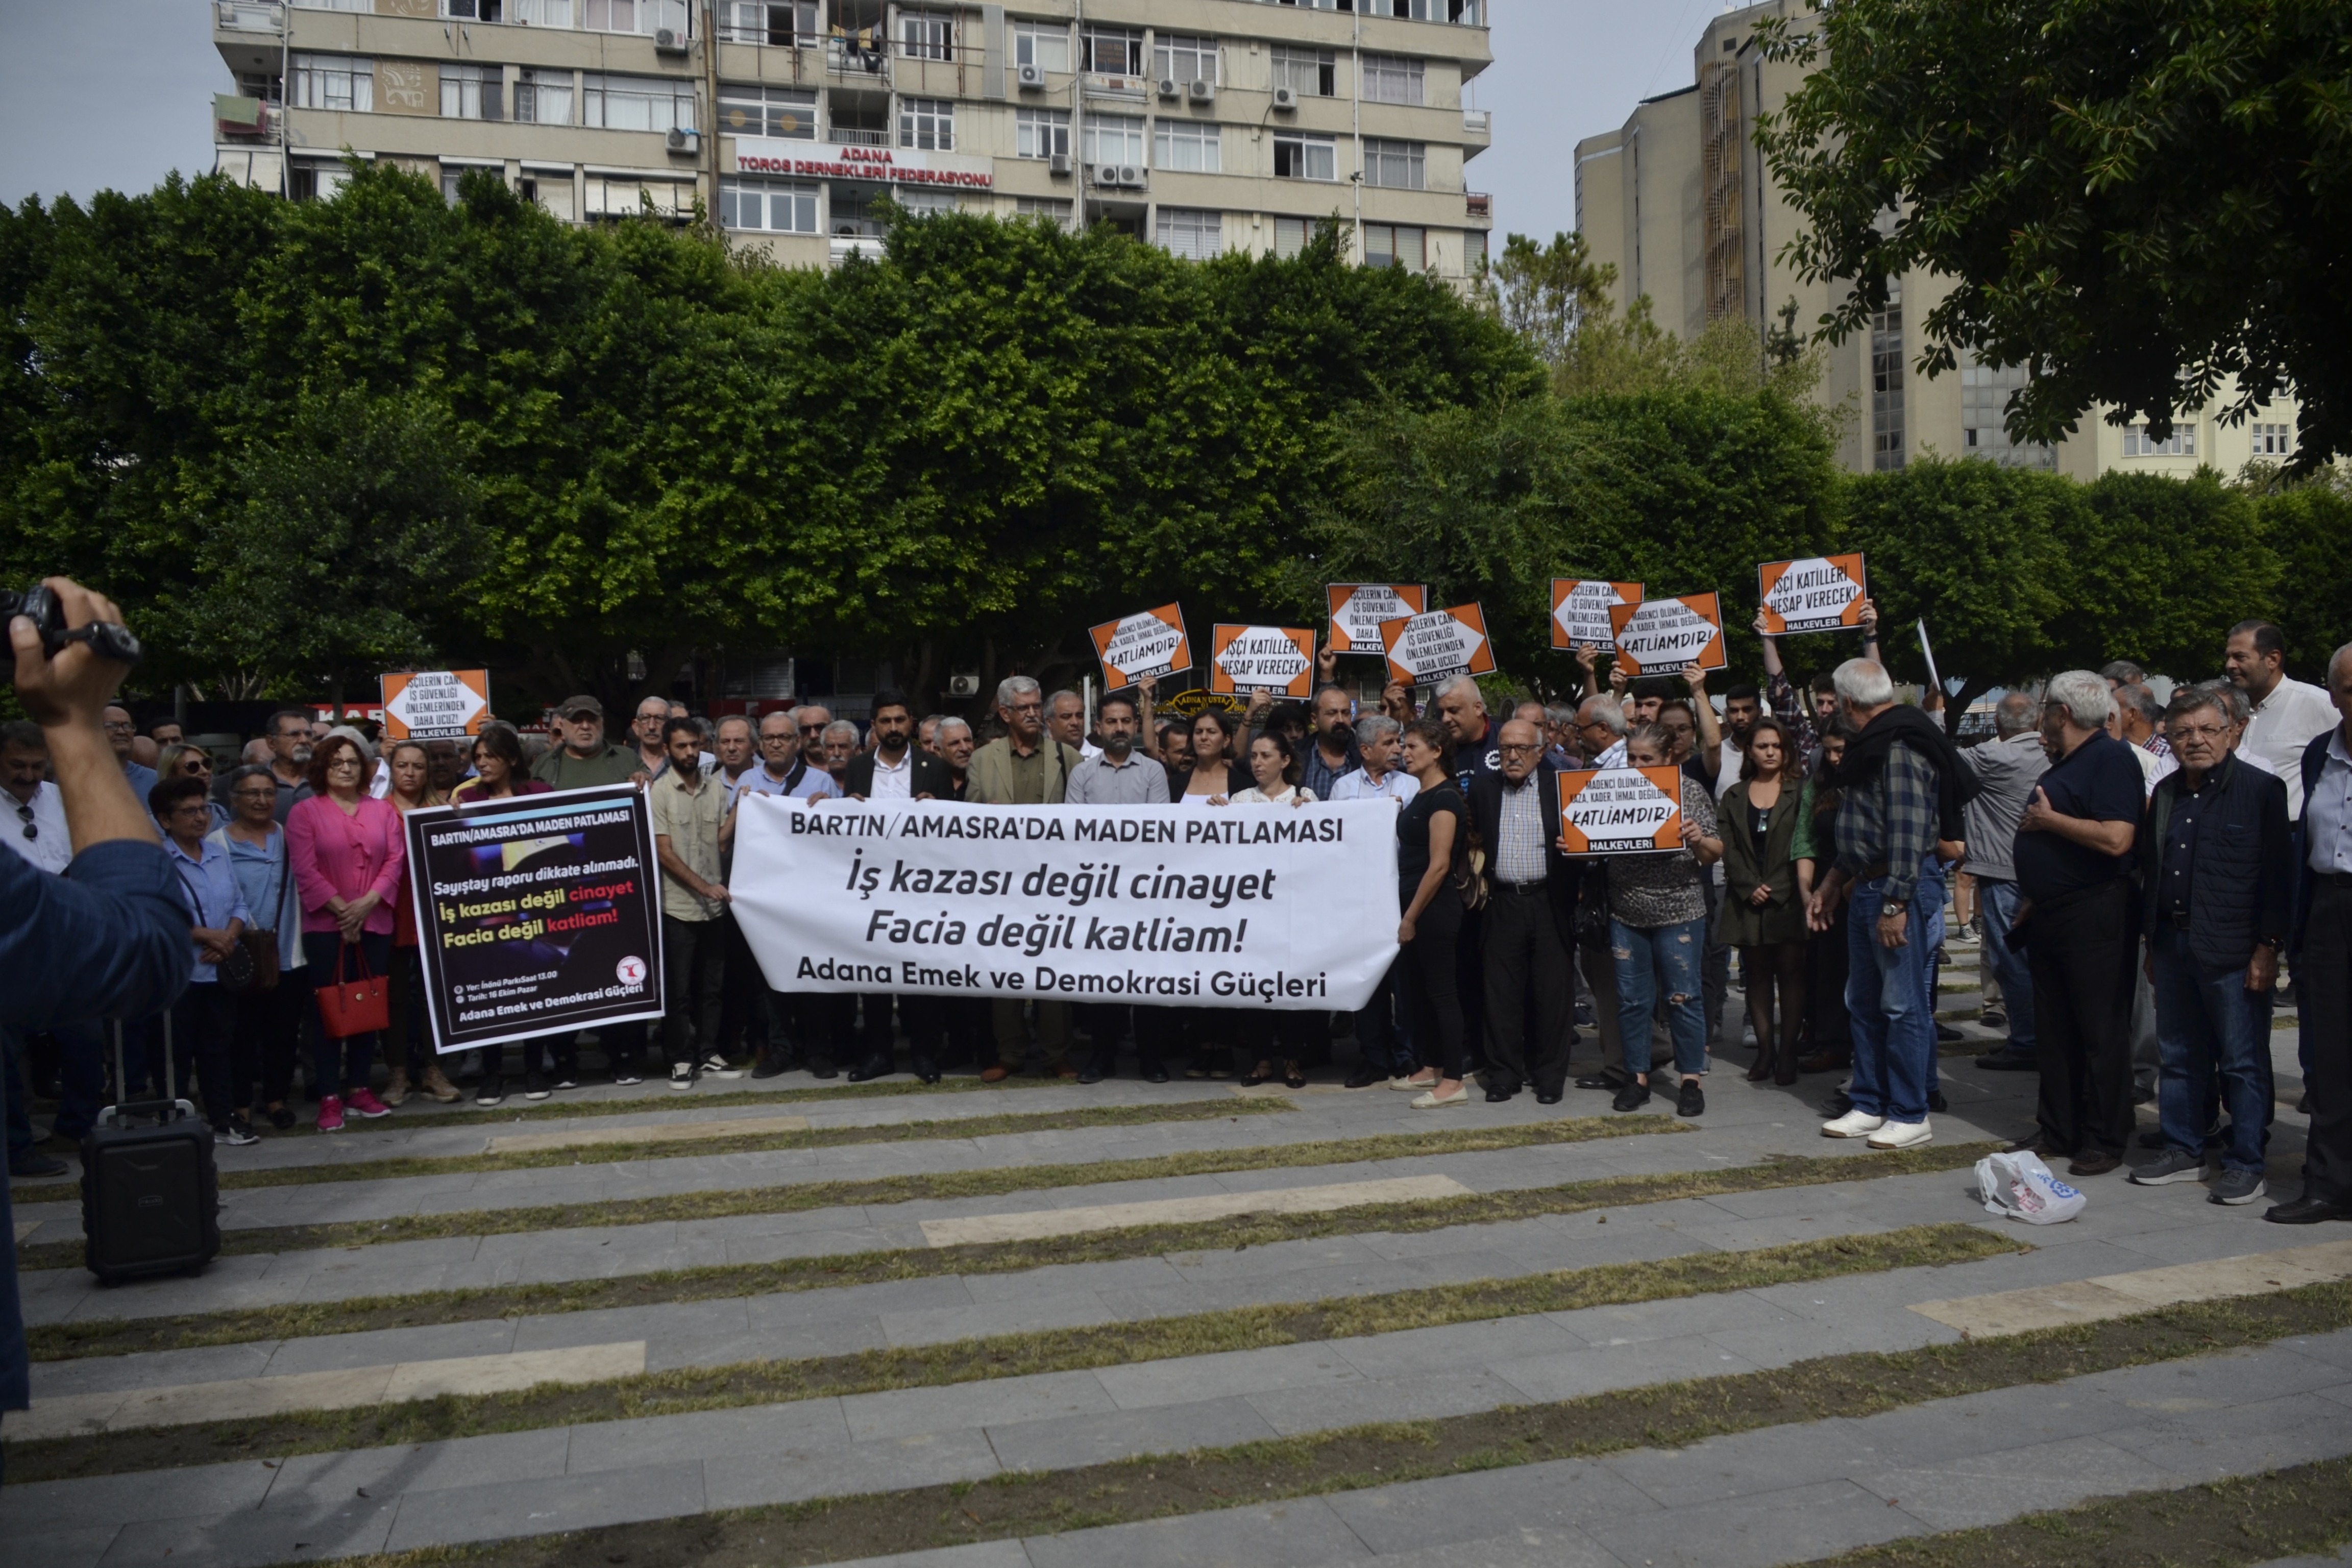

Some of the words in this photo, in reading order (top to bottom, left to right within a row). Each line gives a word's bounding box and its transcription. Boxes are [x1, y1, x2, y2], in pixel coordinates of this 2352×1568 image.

[840, 148, 893, 163] ADANA
[738, 156, 791, 172] TOROS
[795, 161, 887, 179] DERNEKLERİ
[889, 168, 992, 187] FEDERASYONU
[1774, 573, 1793, 596] İŞÇİ
[1797, 563, 1847, 589] KATİLLERİ
[1350, 589, 1381, 600] İŞÇİLERİN
[1384, 590, 1400, 599] CANI
[1571, 584, 1599, 596] İŞÇİLERİN
[1602, 586, 1618, 597] CANI
[1354, 601, 1360, 613] İŞ
[1362, 601, 1396, 612] GÜVENLİĞİ
[1572, 598, 1577, 610] İŞ
[1771, 595, 1801, 615] HESAP
[1806, 585, 1856, 609] VERECEK!
[1403, 617, 1436, 632] İŞÇİLERİN
[1439, 612, 1456, 625] CANI
[1632, 607, 1658, 621] MADENCİ
[1660, 605, 1690, 618] ÖLÜMLERİ
[1136, 616, 1160, 630] ÖLÜMLERİ
[1573, 626, 1587, 636] DAHA
[1590, 627, 1611, 638] UCUZ!
[1659, 620, 1679, 629] İHMAL
[1138, 630, 1153, 641] İHMAL
[1356, 629, 1373, 639] DAHA
[1407, 633, 1415, 646] İŞ
[1417, 625, 1455, 643] GÜVENLİĞİ
[1624, 630, 1712, 653] KATLİAMDIR!
[1111, 636, 1179, 668] KATLİAMDIR!
[1226, 637, 1247, 658] İŞÇİ
[1250, 636, 1300, 655] KATİLLERİ
[1406, 639, 1465, 660] ÖNLEMLERİNDEN
[1221, 659, 1253, 675] HESAP
[1257, 659, 1306, 675] VERECEK!
[1416, 658, 1437, 672] DAHA
[1439, 654, 1461, 667] UCUZ!
[406, 675, 442, 688] İŞÇİLERİN
[444, 675, 461, 685] CANI
[410, 689, 416, 700] İŞ
[420, 688, 457, 699] GÜVENLİĞİ
[406, 701, 465, 714] ÖNLEMLERİNDEN
[414, 716, 434, 726] DAHA
[436, 714, 458, 725] UCUZ!
[1586, 777, 1615, 790] MADENCİ
[1618, 775, 1650, 788] ÖLÜMLERİ
[1590, 792, 1613, 803] KADER,
[1615, 790, 1636, 801] İHMAL
[1638, 789, 1672, 799] DEĞİLDİR!
[535, 817, 573, 833] MADEN
[573, 810, 630, 828] PATLAMASI
[1572, 806, 1671, 826] KATLİAMDIR!
[1075, 819, 1175, 843] MADEN
[1186, 818, 1343, 844] PATLAMASI
[433, 876, 490, 897] Sayıştay
[492, 871, 534, 890] raporu
[535, 865, 581, 881] dikkate
[582, 855, 639, 875] alınmadı.
[846, 848, 882, 900] İş
[889, 859, 1012, 896] kazası
[1022, 863, 1120, 906] değil
[1130, 864, 1277, 909] cinayet
[439, 902, 456, 924] İş
[459, 899, 517, 919] kazası
[520, 888, 566, 912] değil
[569, 880, 634, 903] cinayet
[443, 927, 494, 949] Facia
[498, 919, 544, 942] değil
[546, 909, 619, 933] katliam!
[866, 910, 966, 945] Facia
[976, 914, 1077, 957] değil
[1084, 916, 1248, 953] katliam!
[481, 980, 502, 989] İnönü
[537, 970, 557, 980] 13.00
[796, 956, 892, 983] Adana
[902, 961, 981, 988] Emek
[990, 970, 1024, 991] ve
[1036, 967, 1200, 995] Demokrasi
[1211, 970, 1327, 1003] Güçleri
[459, 1007, 495, 1022] Adana
[497, 1003, 528, 1016] Emek
[529, 1001, 543, 1010] ve
[545, 988, 603, 1008] Demokrasi
[605, 983, 644, 1000] Güçleri
[468, 993, 487, 1002] Tarih:
[499, 989, 516, 997] Ekim
[517, 986, 537, 994] Pazar
